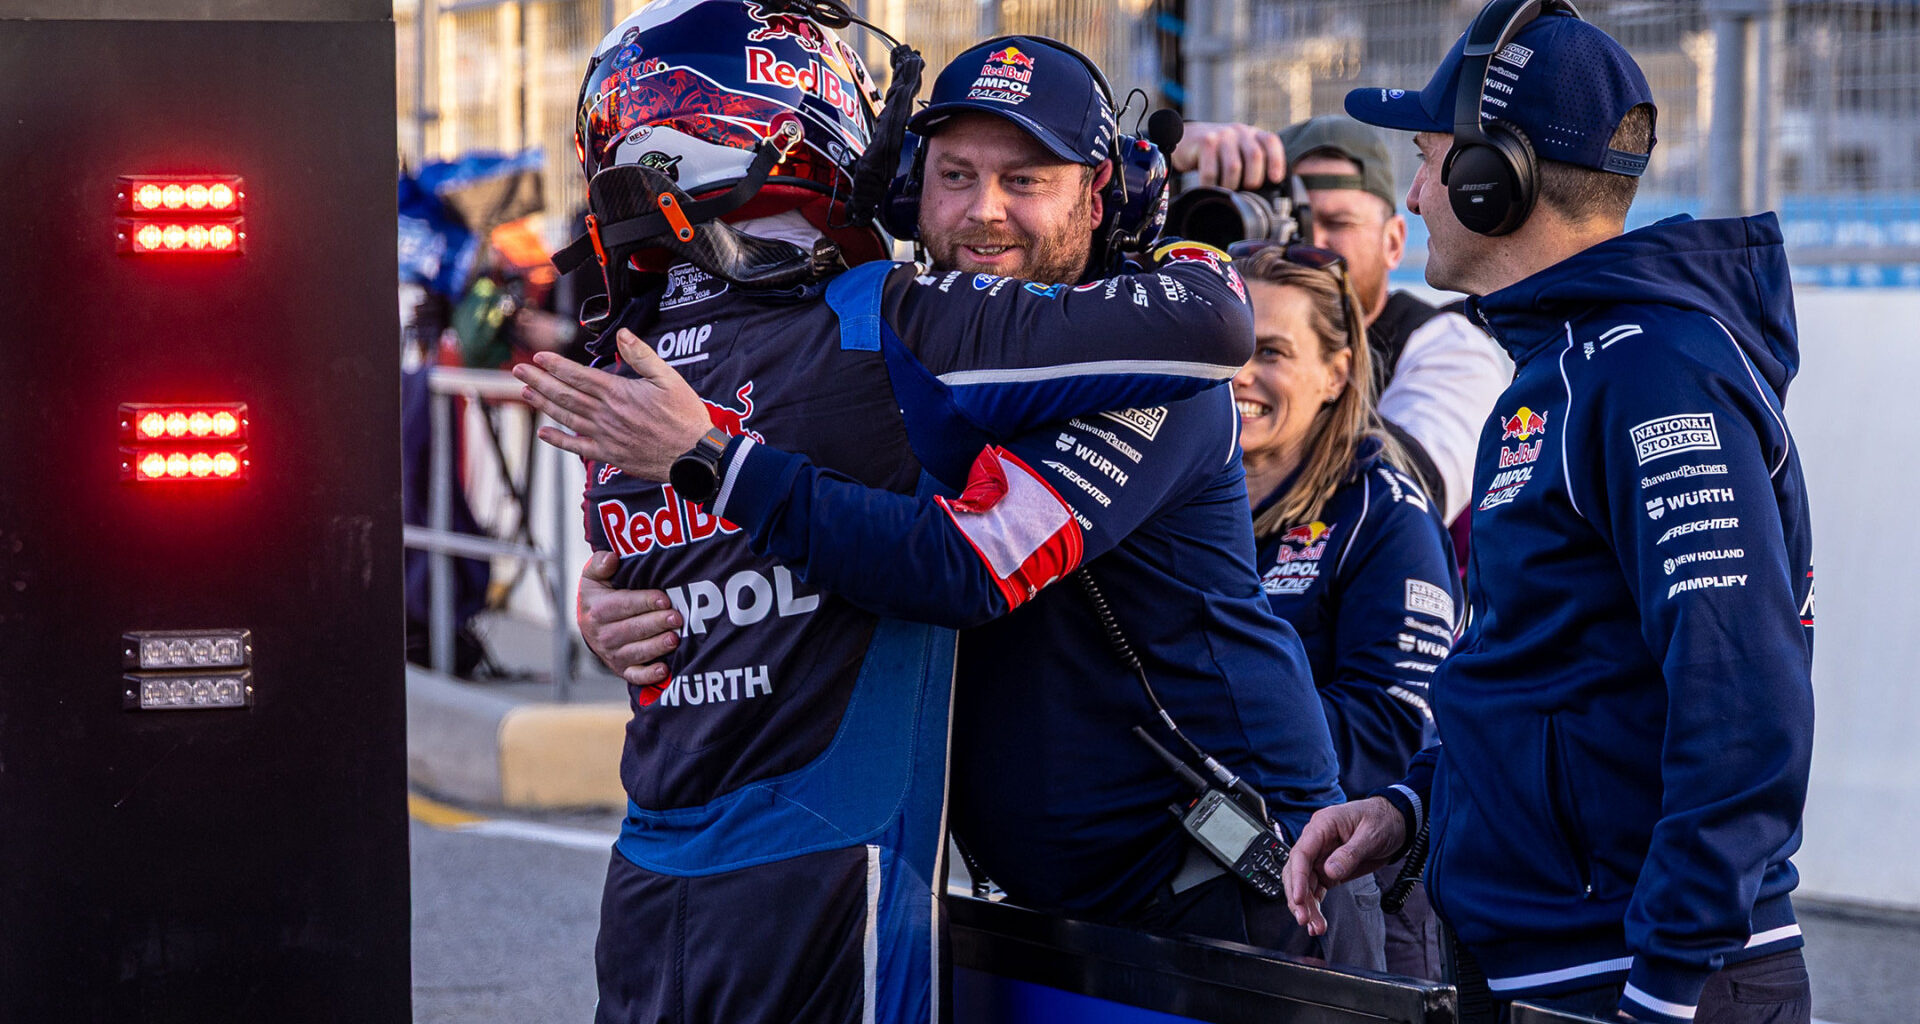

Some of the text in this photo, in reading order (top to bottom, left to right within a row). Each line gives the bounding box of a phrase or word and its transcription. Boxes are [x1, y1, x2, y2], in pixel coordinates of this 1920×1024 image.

[745, 46, 820, 99] Red
[981, 64, 1032, 84] Red Bull
[967, 89, 1026, 103] RACING
[971, 77, 1031, 96] AMPOL
[629, 128, 650, 142] BELL
[1460, 182, 1495, 191] BOSE
[656, 323, 712, 359] OMP
[1068, 418, 1144, 465] ShawandPartners
[1634, 417, 1711, 442] NATIONAL
[1499, 439, 1543, 468] Red Bull
[1641, 431, 1711, 454] STORAGE
[1075, 442, 1129, 488] WÜRTH
[1641, 463, 1729, 489] ShawandPartners
[1048, 461, 1112, 509] FREIGHTER
[1488, 466, 1534, 491] AMPOL
[1666, 488, 1734, 511] WÜRTH
[598, 483, 687, 559] Red
[1661, 517, 1739, 542] FREIGHTER
[1674, 548, 1745, 567] NEW HOLLAND
[1674, 574, 1748, 594] AMPLIFY
[666, 565, 820, 638] MPOL
[660, 664, 773, 707] WÜRTH
